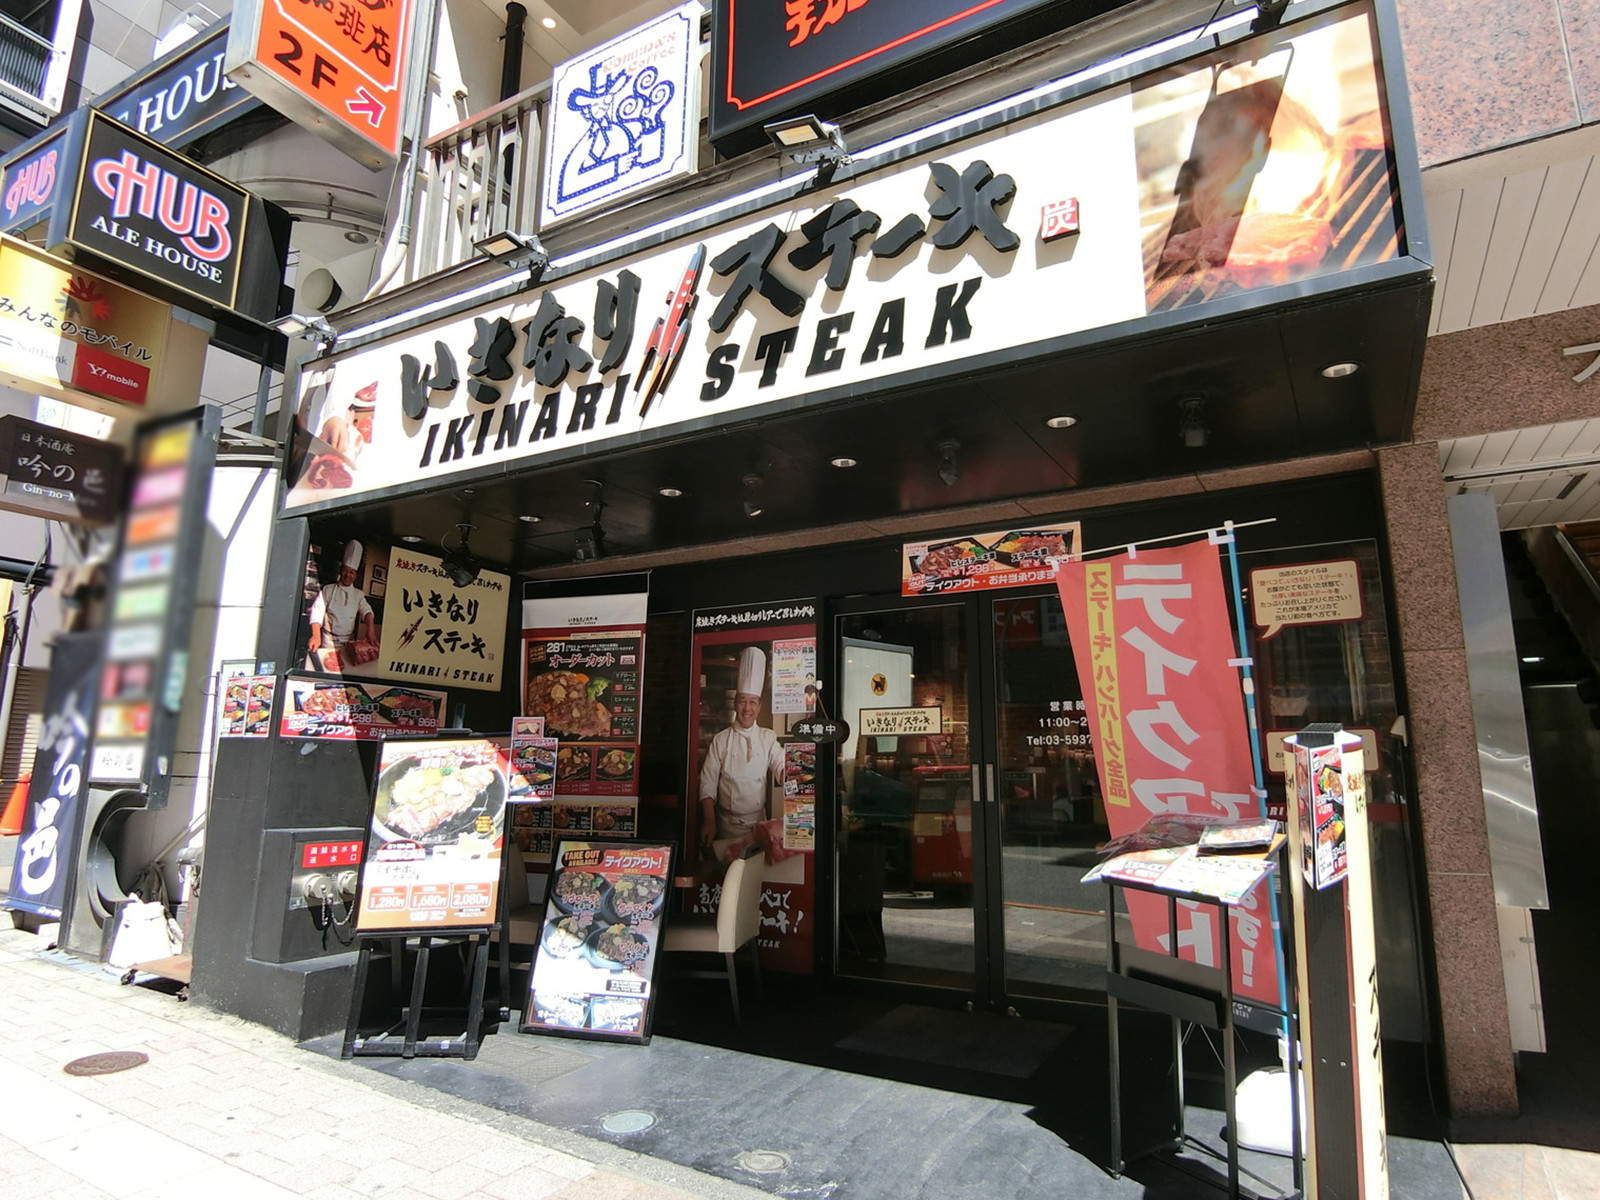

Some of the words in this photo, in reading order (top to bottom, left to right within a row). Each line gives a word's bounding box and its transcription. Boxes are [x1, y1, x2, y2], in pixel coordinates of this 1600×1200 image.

[274, 30, 339, 89] 2F
[6, 149, 58, 219] HUB
[92, 148, 233, 263] HUB
[1042, 198, 1079, 242] 炭
[91, 215, 141, 249] ALE
[145, 236, 224, 285] HOUSE
[400, 269, 641, 421] いきなり
[709, 159, 1021, 334] ステーキ
[0, 297, 153, 362] みんなのモバイル
[16, 339, 69, 366] SoftBank
[420, 373, 630, 469] IKINARI
[700, 275, 982, 402] STEAK
[21, 432, 76, 456] 日本酒庵
[402, 587, 479, 625] いきなり
[423, 628, 487, 659] ステーキ
[389, 661, 441, 677] IKINARI
[453, 668, 495, 684] STEAK
[548, 652, 616, 668] オーダーカット
[798, 723, 837, 736] 準備中
[866, 716, 898, 728] いきなり
[904, 715, 931, 727] ステーキ
[564, 850, 584, 860] TAKE
[585, 850, 600, 859] OUT
[568, 858, 599, 867] AVAILABLE
[604, 855, 663, 870] テイクアウト!
